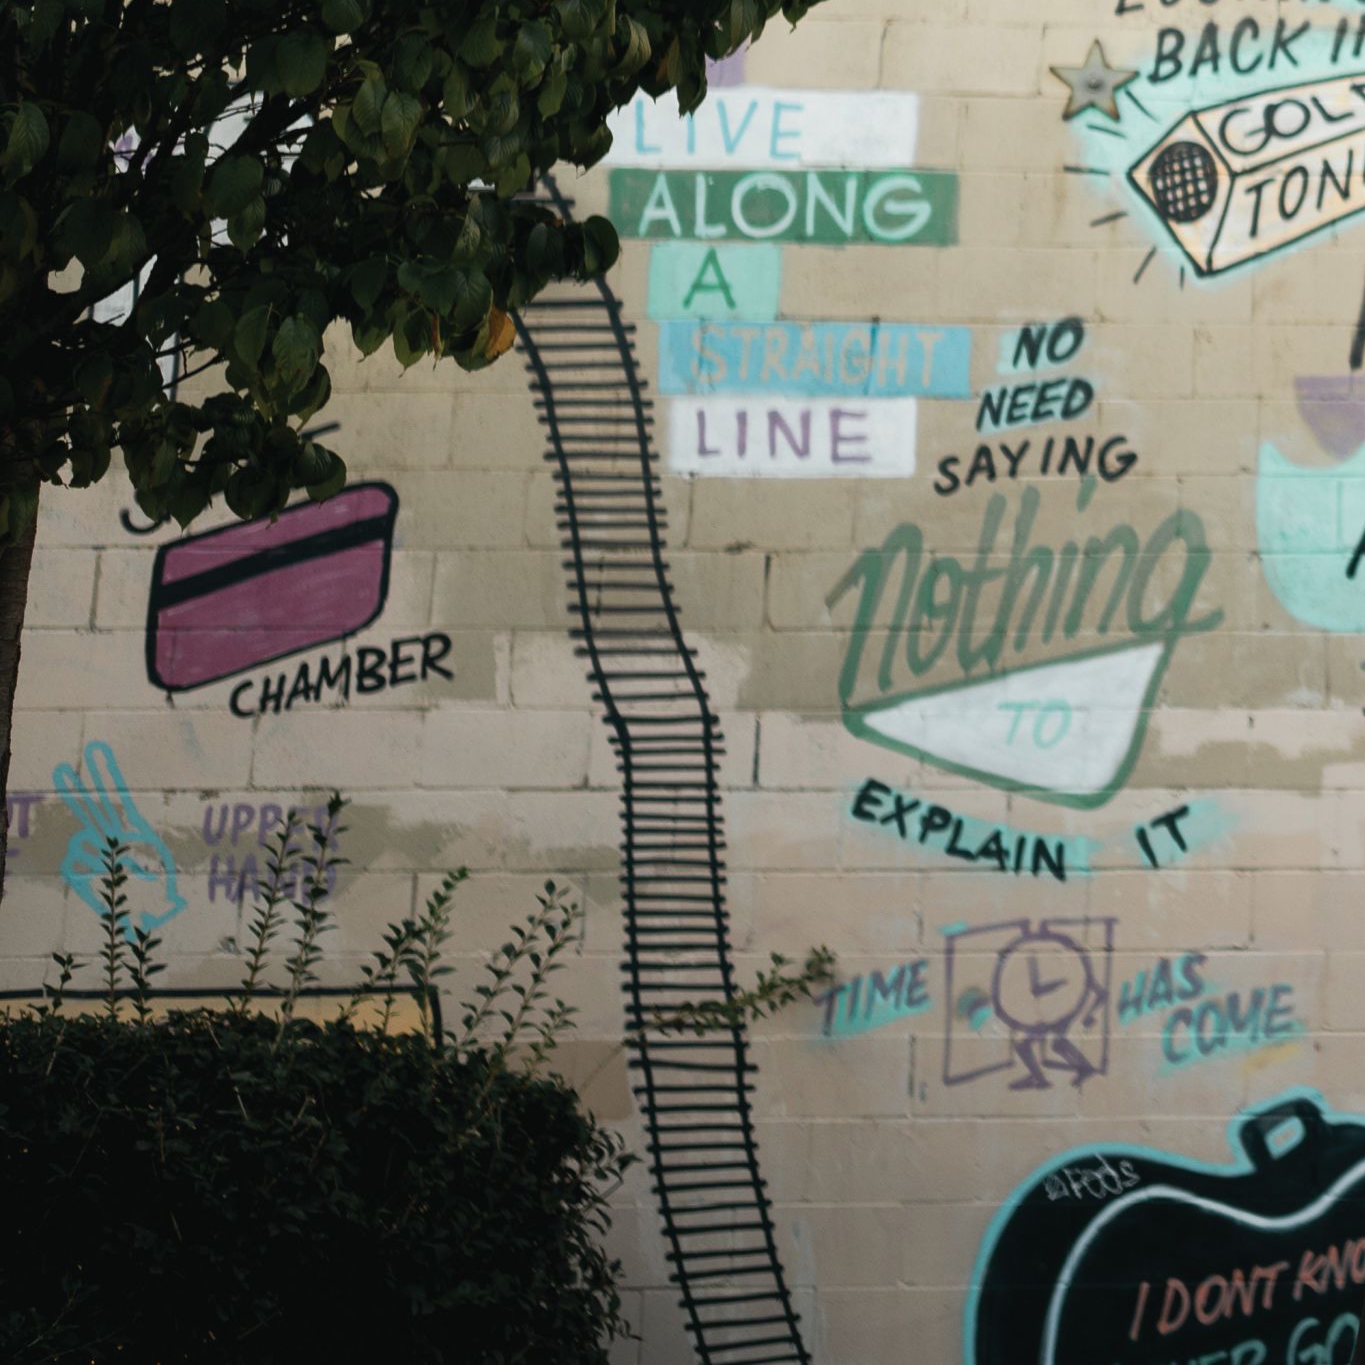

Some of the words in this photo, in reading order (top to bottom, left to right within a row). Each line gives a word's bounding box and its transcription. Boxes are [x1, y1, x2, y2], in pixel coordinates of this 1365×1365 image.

[1148, 15, 1305, 85] BACK
[634, 98, 805, 161] LIVE
[638, 172, 932, 240] ALONG
[683, 247, 737, 309] A
[689, 324, 945, 388] STRAIGHT
[1011, 316, 1085, 370] NO
[695, 407, 875, 465] LINE
[975, 377, 1095, 432] NEED
[933, 435, 1139, 495] SAYING
[229, 632, 456, 719] CHAMBER
[996, 697, 1075, 751] TO
[203, 802, 339, 853] UPPER
[850, 777, 1067, 884] EXPLAIN
[1133, 802, 1192, 870] IT
[208, 852, 338, 906] HAND
[812, 959, 931, 1037] TIME
[1118, 953, 1207, 1022] HAS
[1160, 983, 1304, 1065] COME
[1129, 1281, 1150, 1342] I
[1156, 1259, 1291, 1337] DONT
